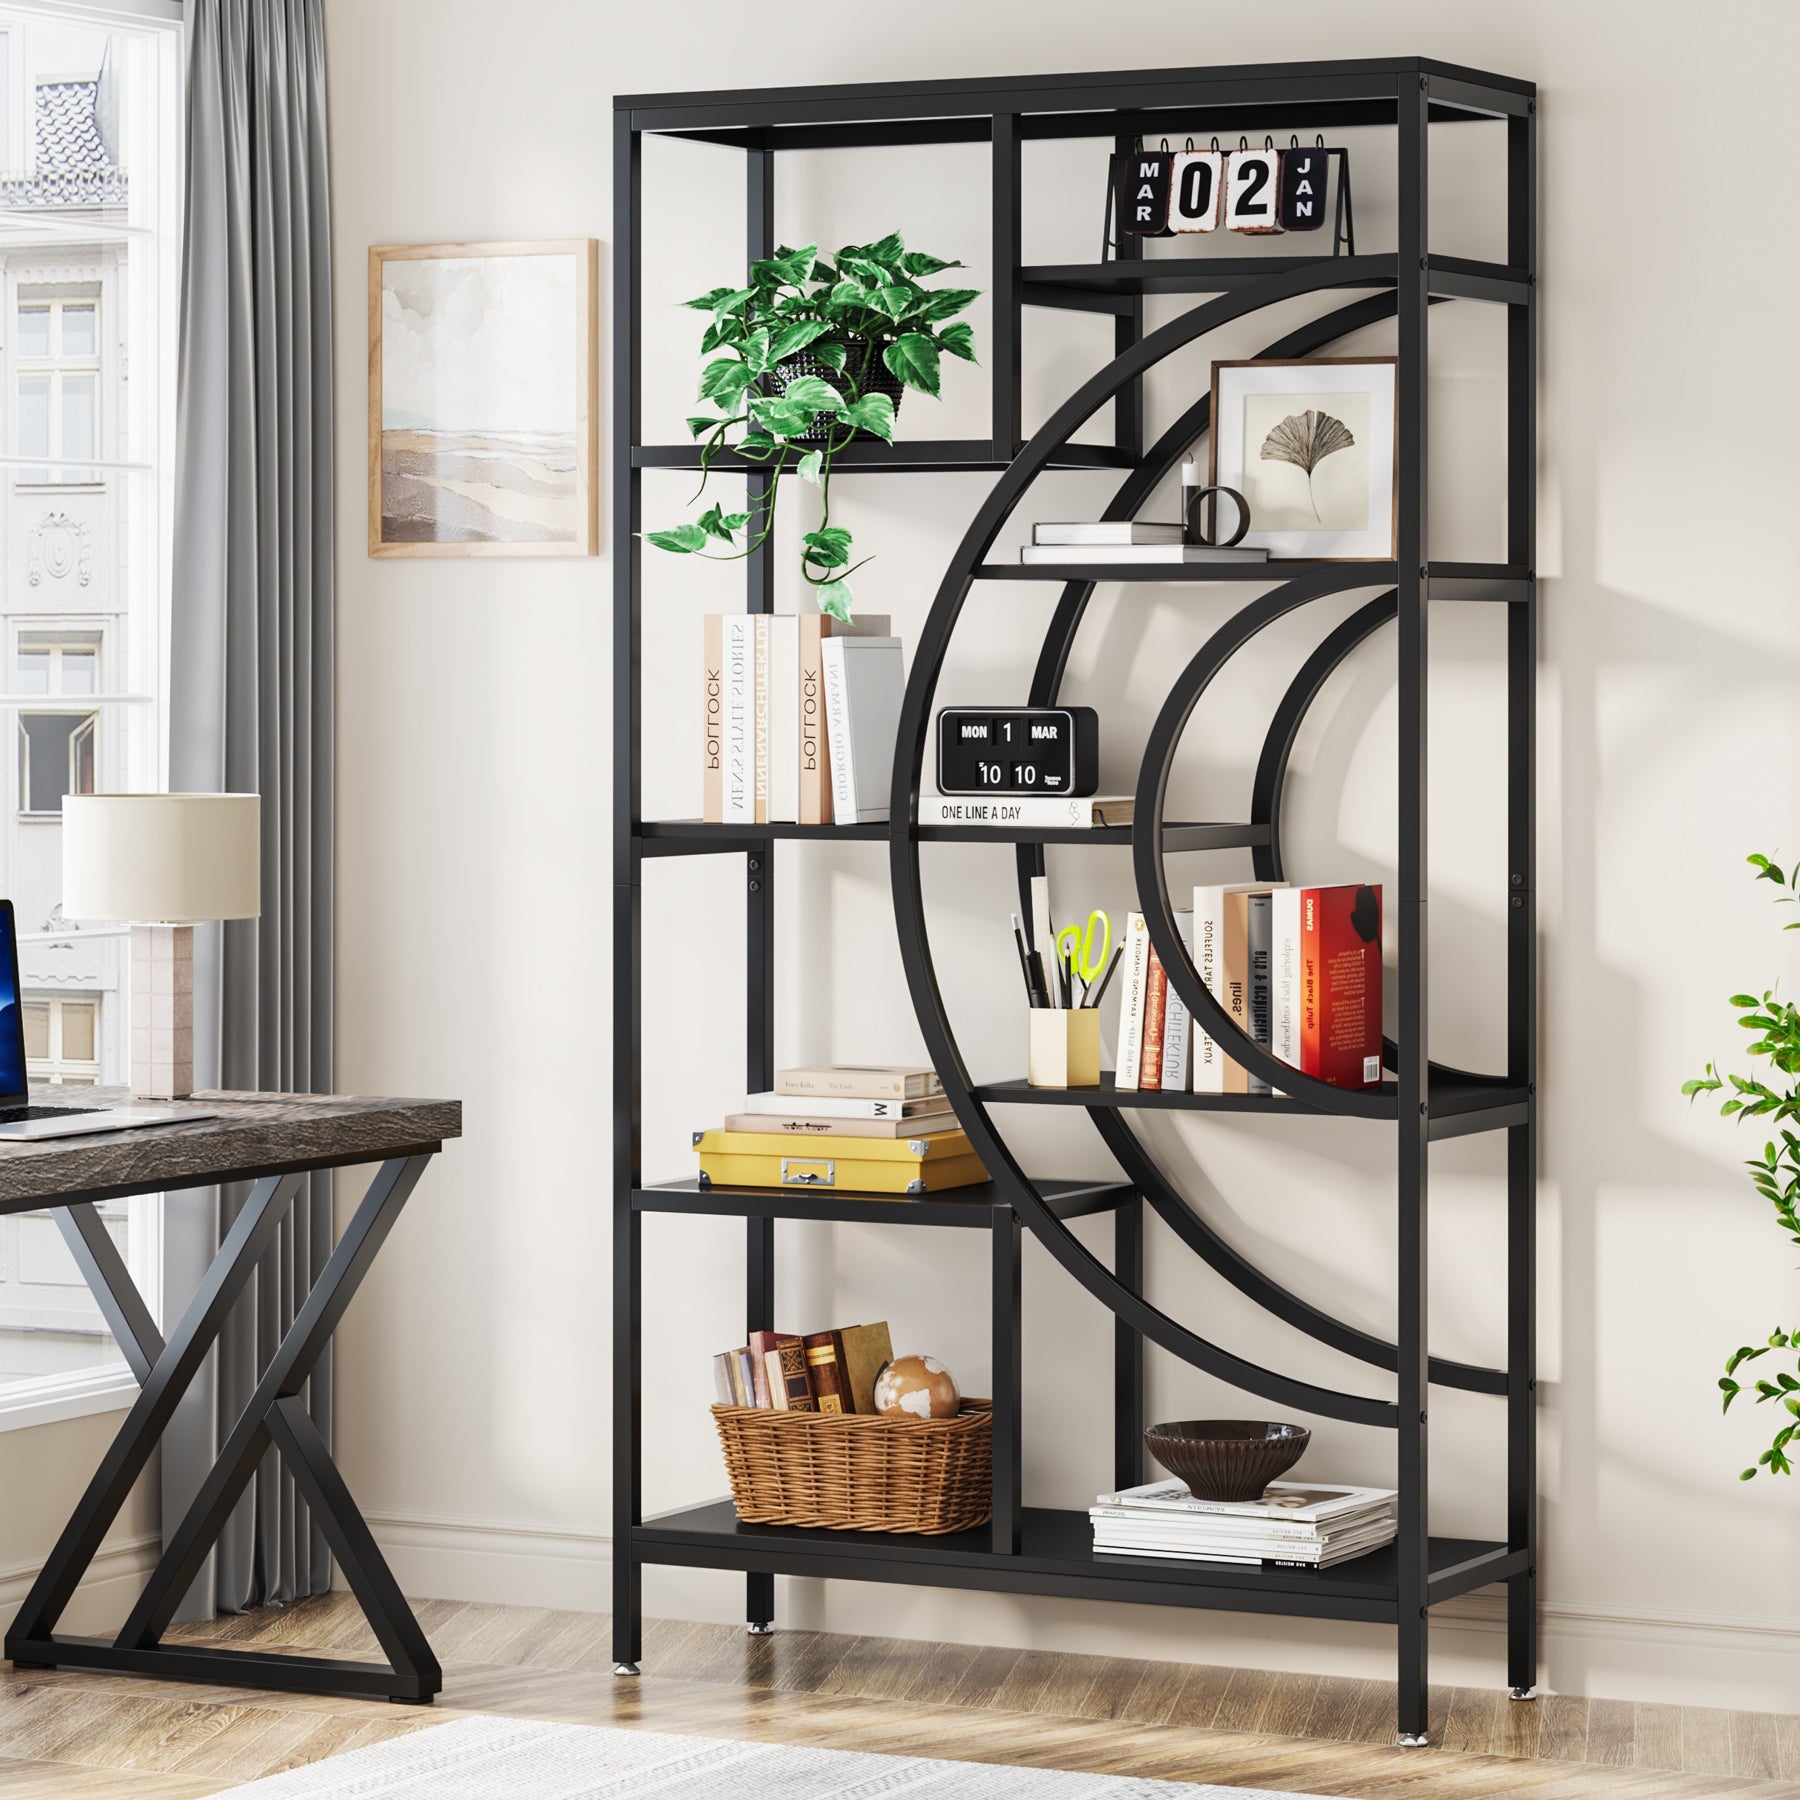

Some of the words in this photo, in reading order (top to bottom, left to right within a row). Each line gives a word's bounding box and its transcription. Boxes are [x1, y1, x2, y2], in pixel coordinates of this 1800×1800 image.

[1136, 162, 1159, 221] MAR
[1179, 161, 1212, 219] 0
[1235, 159, 1269, 216] 2
[1296, 158, 1313, 217] JAN
[961, 725, 987, 739] MON
[1003, 722, 1012, 742] 1
[1031, 726, 1058, 739] MAR
[980, 765, 1001, 784] 10
[1015, 765, 1036, 784] 10
[942, 805, 962, 820] ONE
[965, 805, 988, 820] LINE
[991, 806, 998, 820] A
[1001, 806, 1021, 821] DAY
